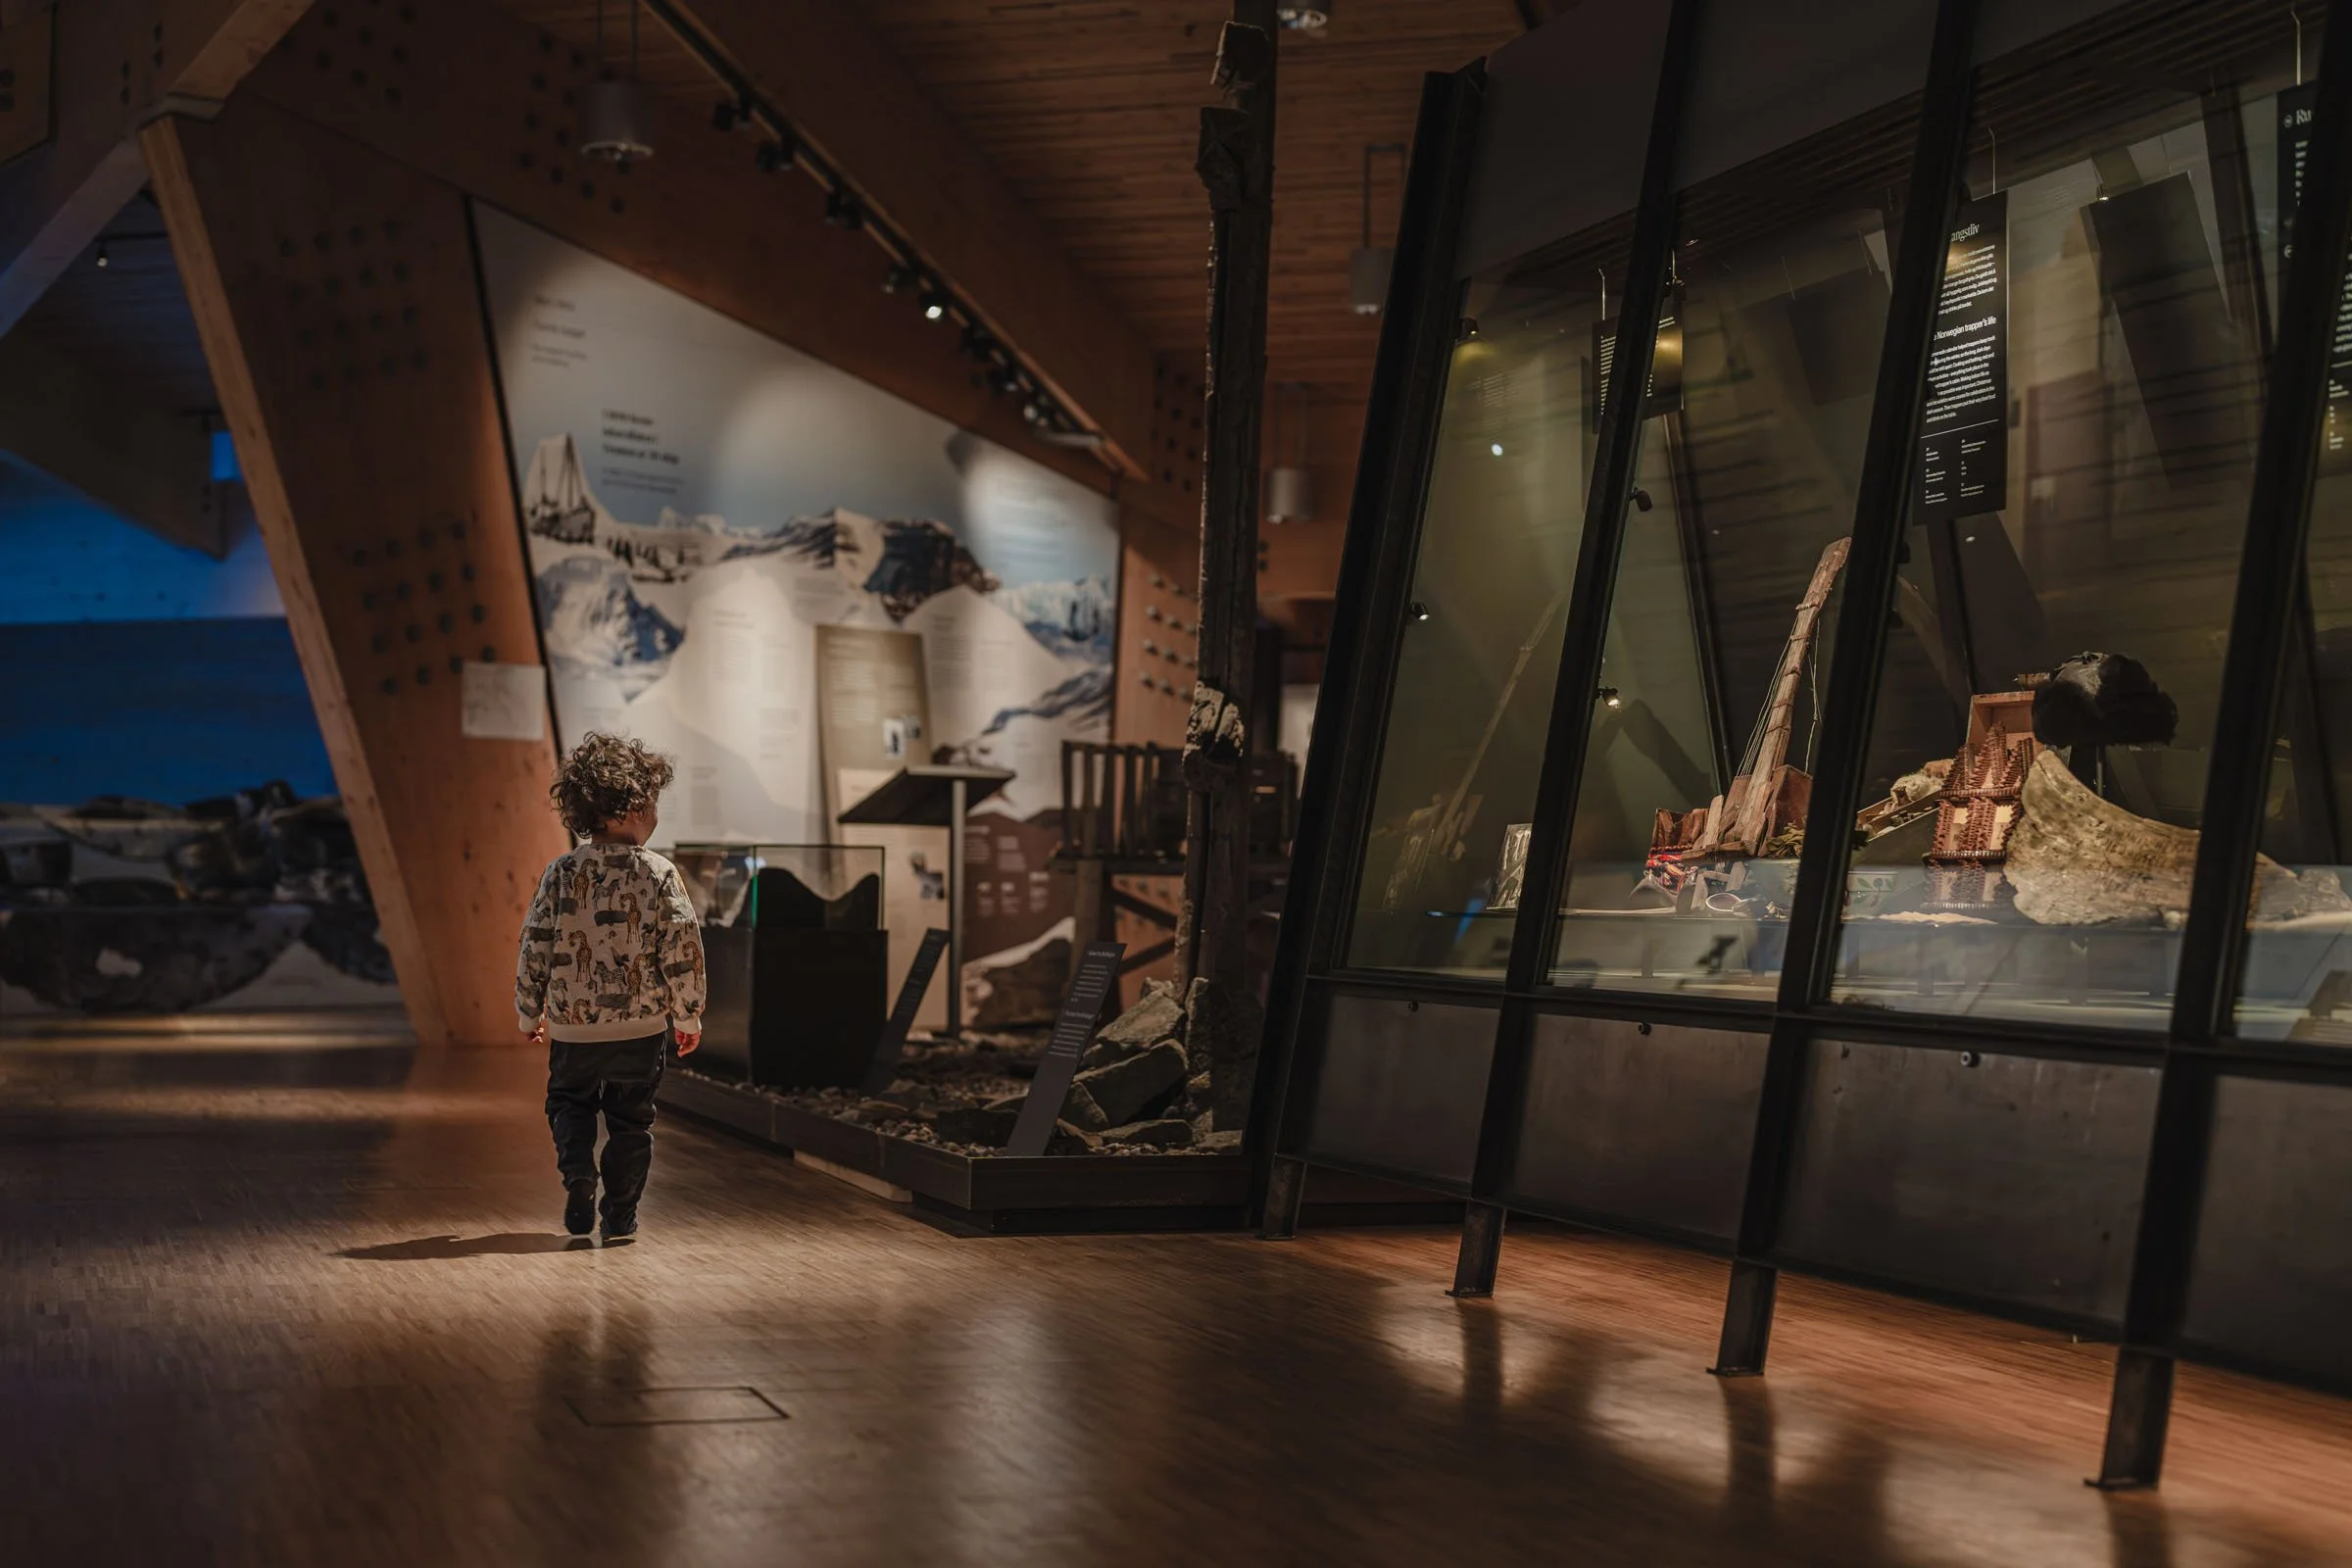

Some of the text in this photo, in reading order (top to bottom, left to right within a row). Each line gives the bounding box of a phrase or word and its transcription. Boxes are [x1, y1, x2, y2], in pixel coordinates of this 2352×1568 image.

[1951, 223, 1980, 242] angstliv
[1937, 326, 1964, 339] Norwegian
[1965, 318, 1987, 332] trapper's
[1987, 316, 1996, 325] life
